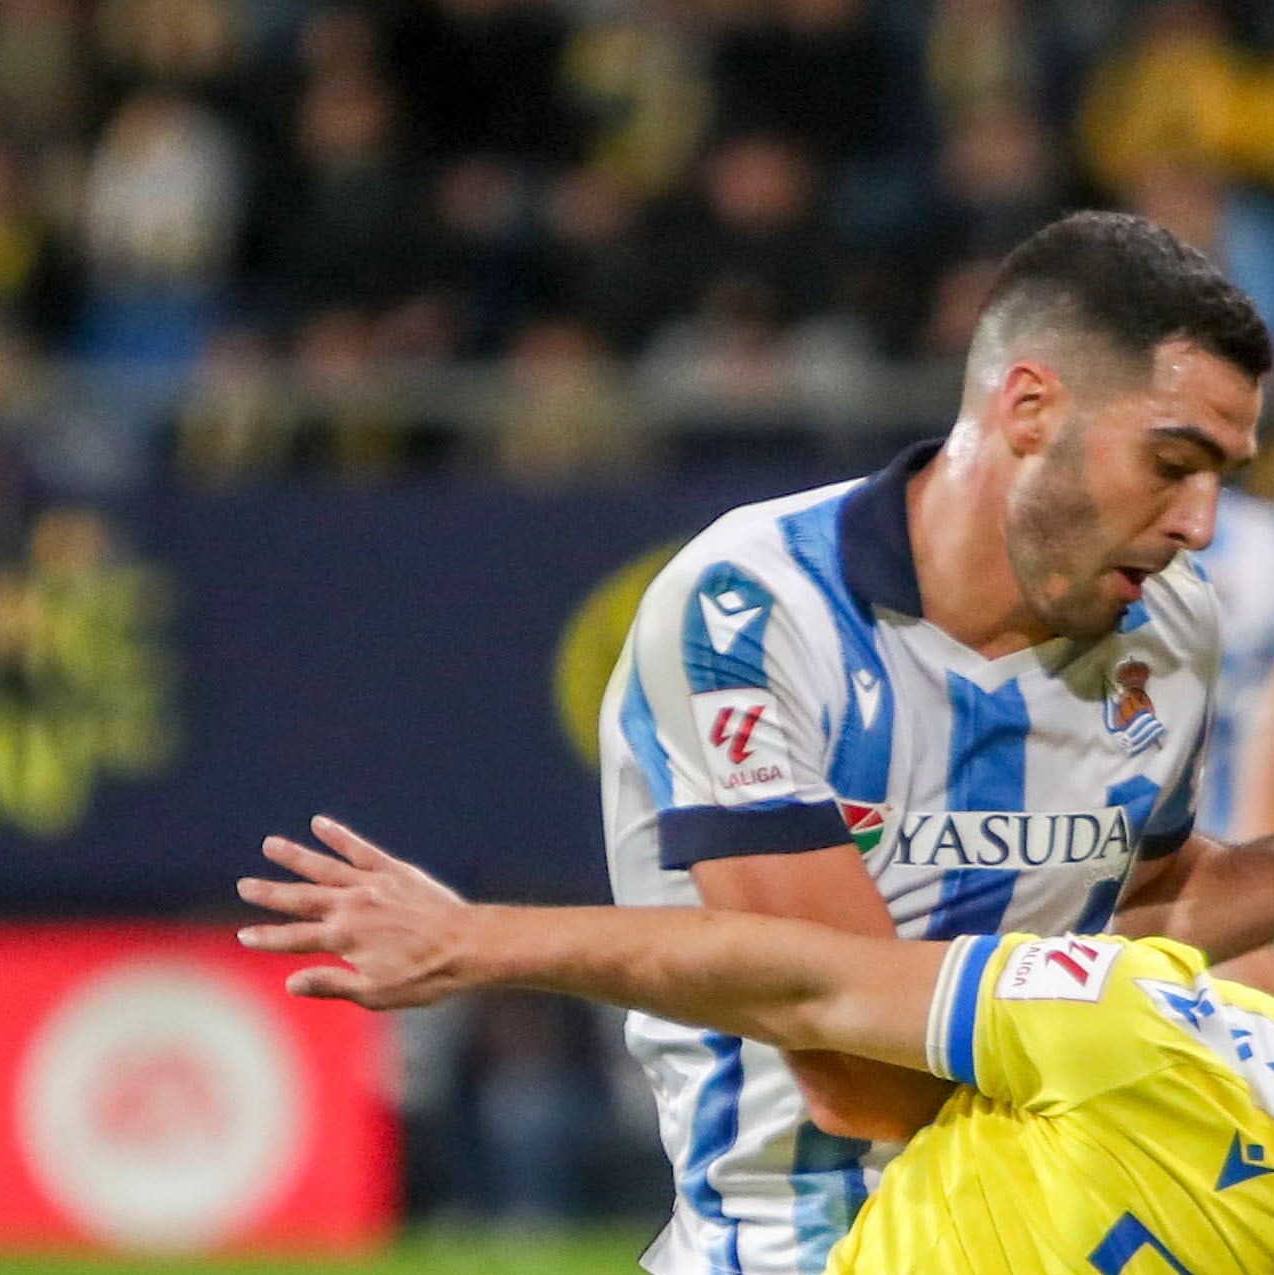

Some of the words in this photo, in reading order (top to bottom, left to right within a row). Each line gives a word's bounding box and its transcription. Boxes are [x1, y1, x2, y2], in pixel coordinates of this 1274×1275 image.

[718, 765, 783, 789] LALIGA
[892, 807, 1129, 865] YASUDA
[1012, 943, 1042, 988] ALIGA
